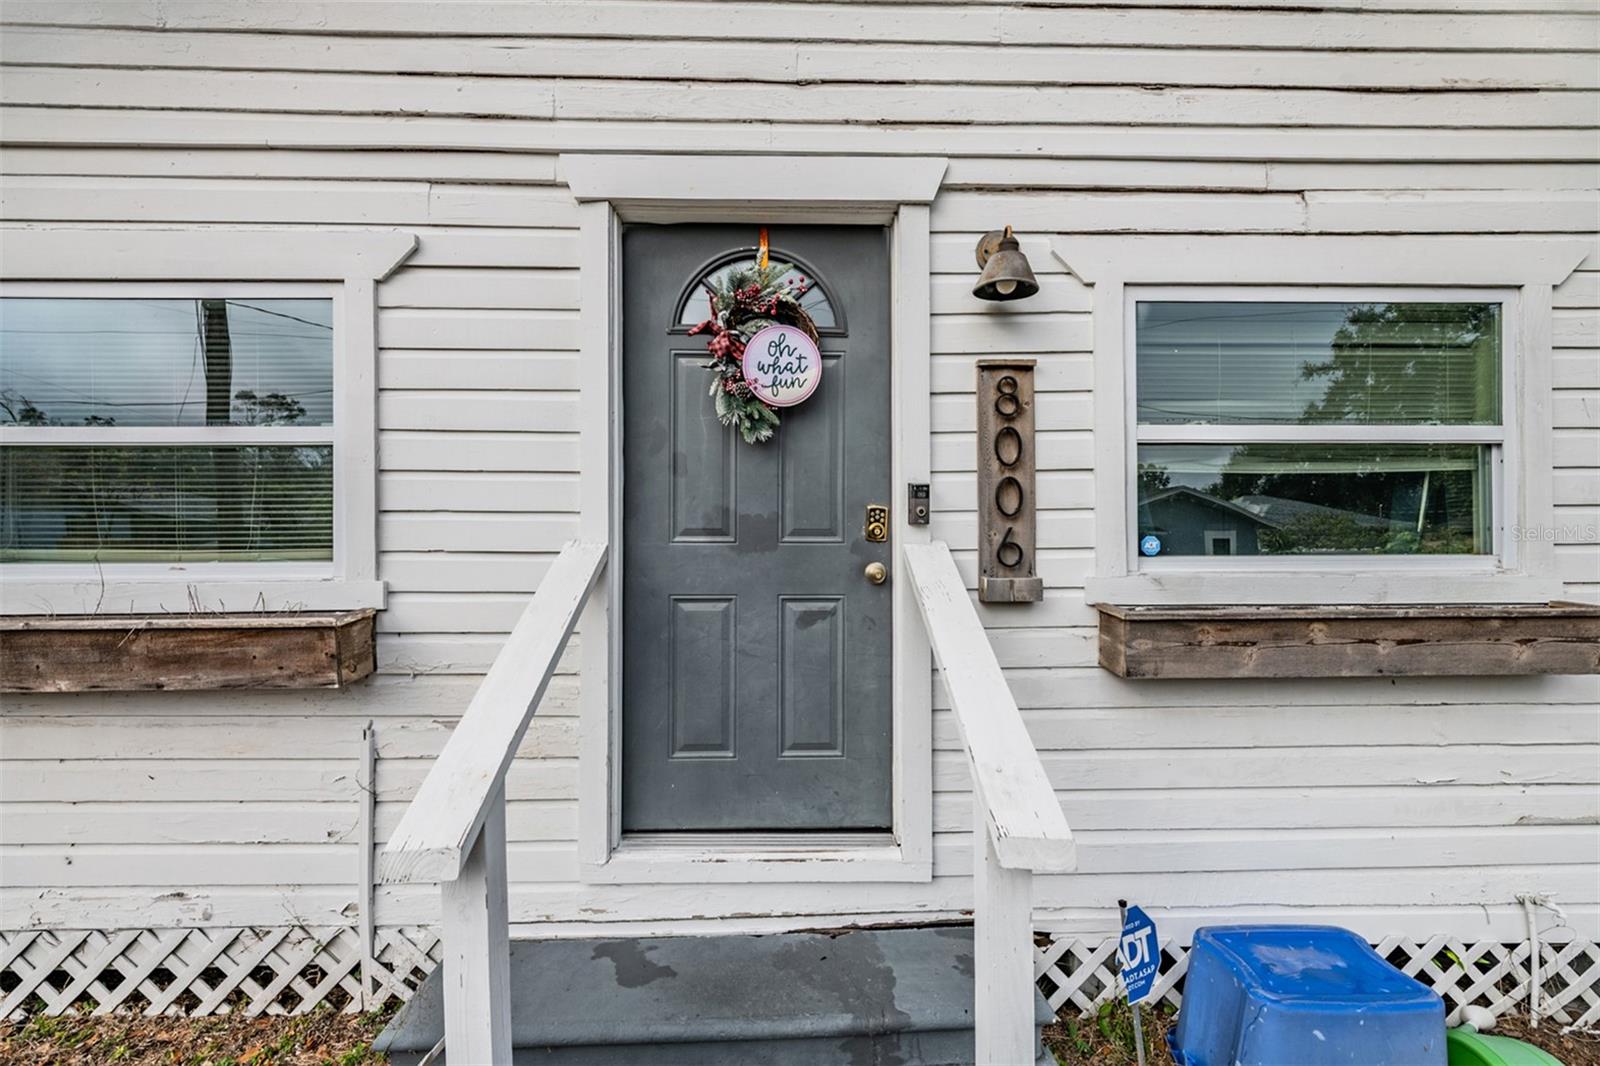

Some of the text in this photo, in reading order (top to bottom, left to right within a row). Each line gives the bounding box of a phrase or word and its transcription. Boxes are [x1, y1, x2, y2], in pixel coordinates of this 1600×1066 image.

[768, 333, 797, 357] oh
[757, 354, 808, 375] what
[761, 375, 807, 397] fun
[994, 375, 1024, 568] 8006
[1115, 925, 1152, 971] ADT
